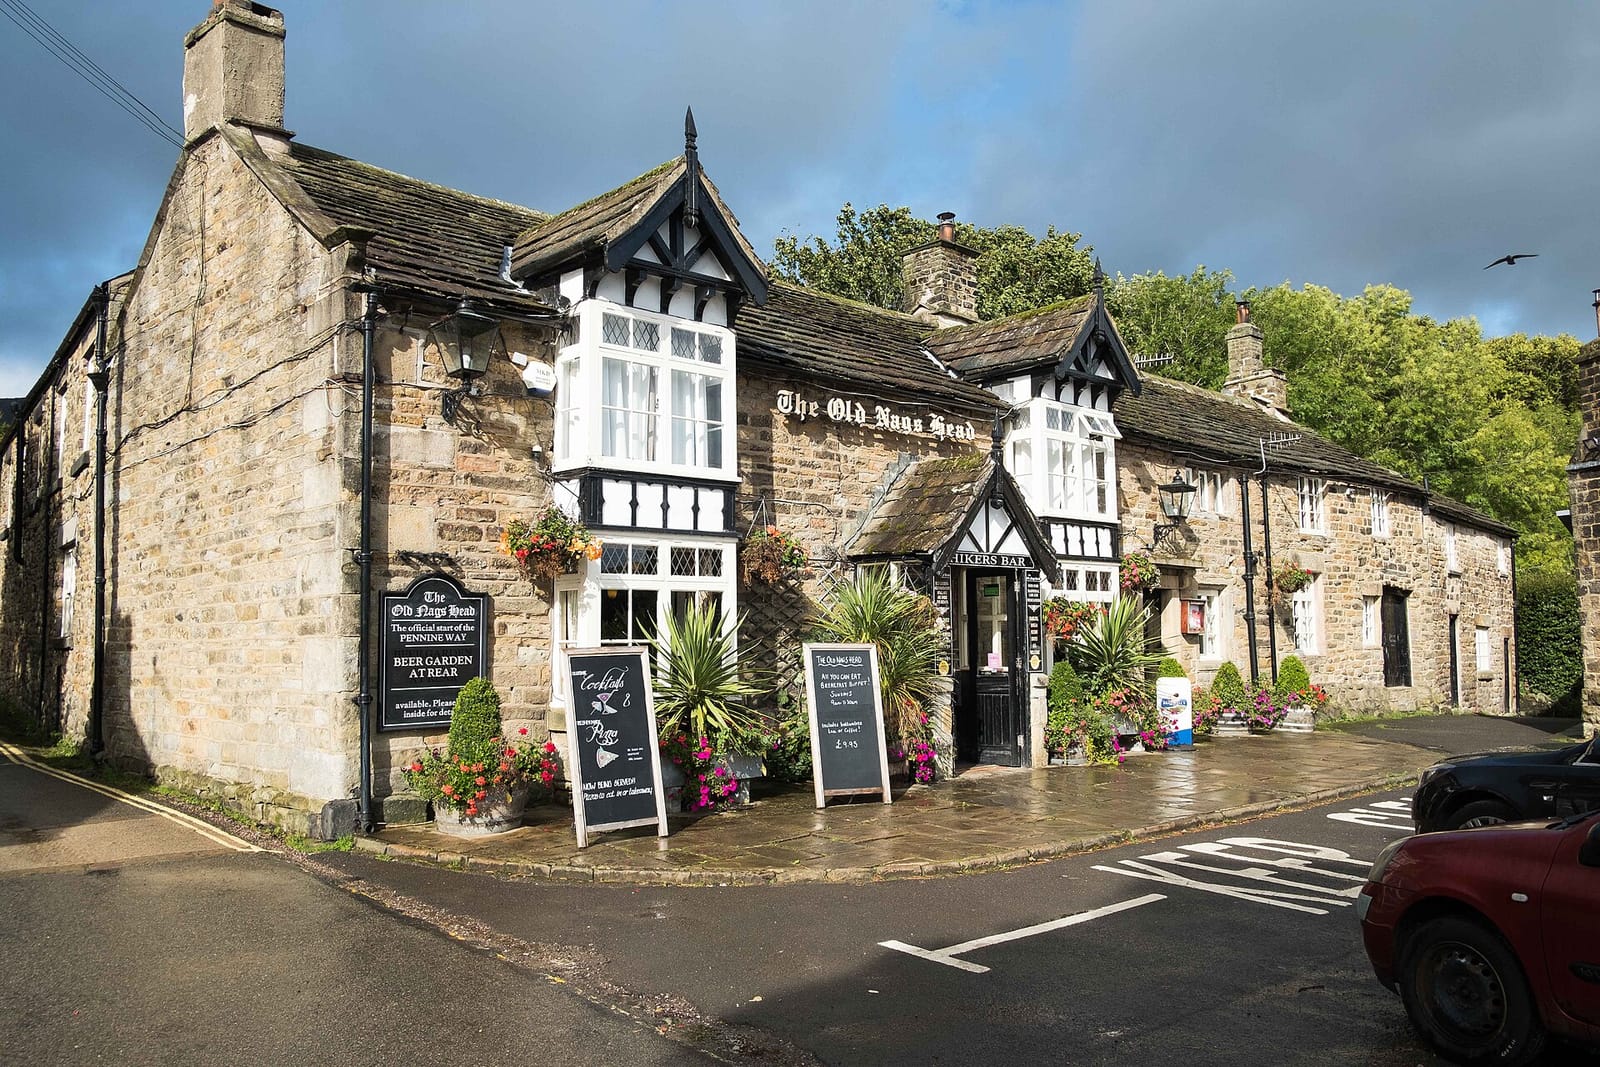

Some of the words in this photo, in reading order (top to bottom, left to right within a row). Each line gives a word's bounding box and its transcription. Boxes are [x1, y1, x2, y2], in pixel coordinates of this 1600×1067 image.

[777, 389, 819, 421] The
[827, 398, 866, 424] Old
[874, 405, 923, 435] Nags
[928, 412, 976, 442] Head
[1001, 556, 1026, 567] BAR
[423, 591, 446, 604] The
[391, 604, 413, 617] Old
[415, 604, 448, 618] Nags
[448, 604, 476, 618] Head
[391, 624, 407, 632] The
[408, 624, 435, 632] official
[436, 624, 454, 632] start
[454, 624, 463, 632] of
[463, 624, 475, 632] the
[400, 633, 444, 642] PENNINE
[445, 633, 467, 642] WAY
[393, 656, 424, 667] BEER
[425, 656, 473, 666] GARDEN
[409, 668, 426, 678] AT
[427, 667, 458, 678] REAR
[581, 666, 629, 690] Cocktails
[395, 700, 431, 709] available.
[433, 699, 456, 707] Please
[403, 709, 426, 718] inside
[427, 708, 438, 717] for
[586, 722, 619, 746] Pizza
